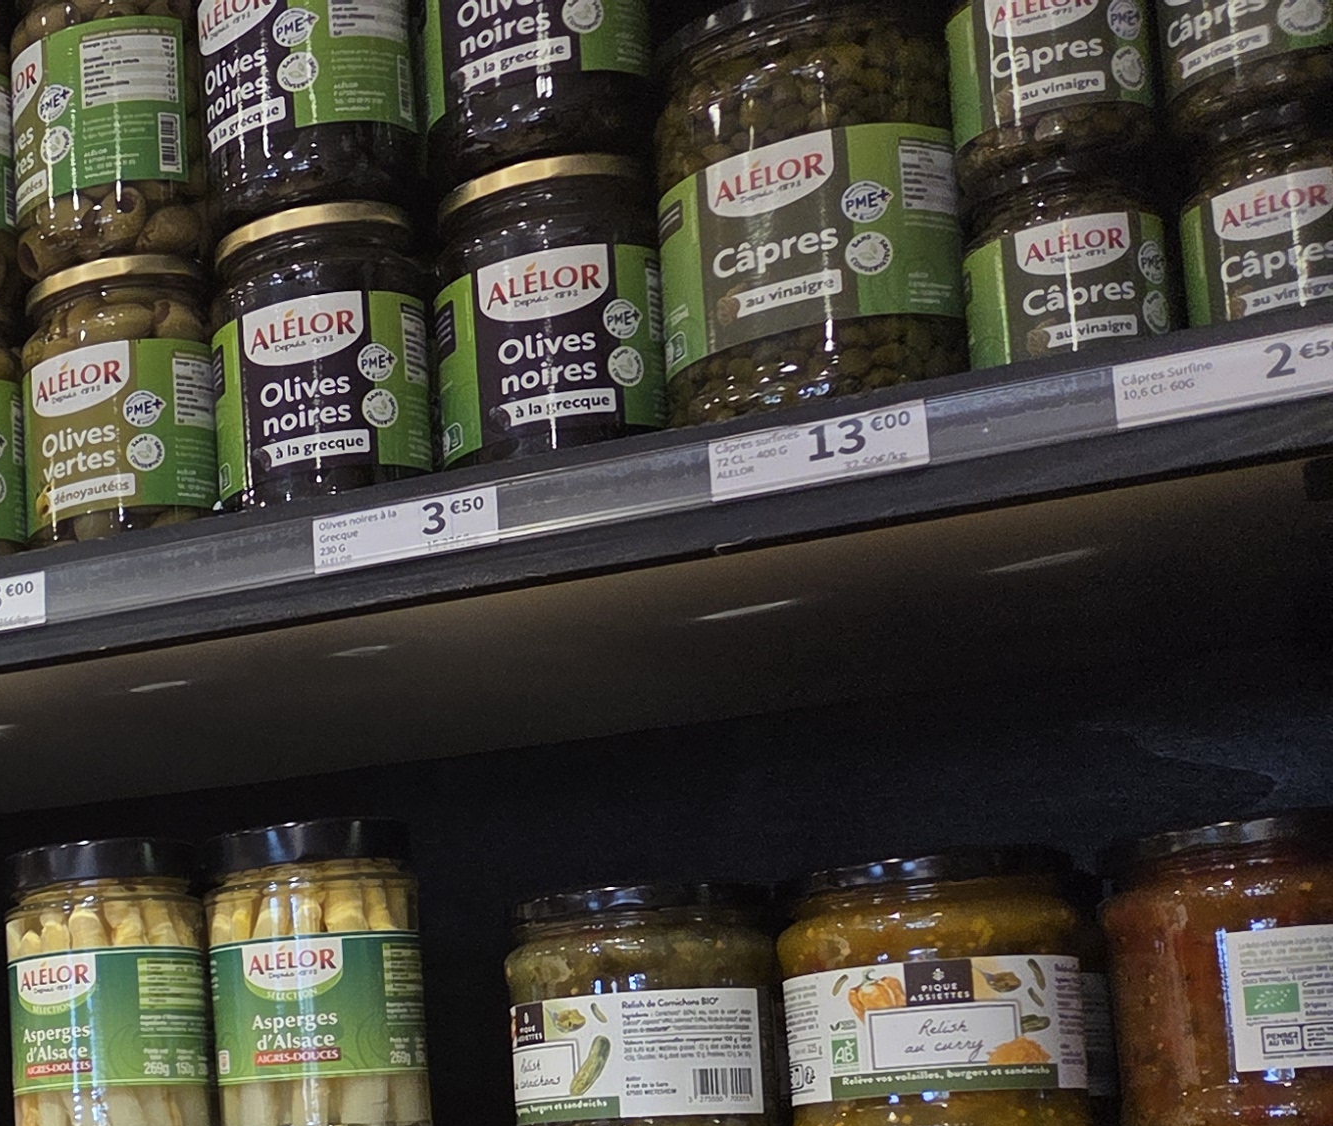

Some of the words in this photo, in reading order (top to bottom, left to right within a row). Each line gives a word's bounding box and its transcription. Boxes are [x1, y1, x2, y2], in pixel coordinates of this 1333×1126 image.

[459, 10, 551, 58] noires
[204, 46, 268, 94] Olives
[991, 37, 1104, 79] Câpres
[205, 76, 268, 125] noires
[714, 149, 825, 208] ALÉLOR
[1220, 183, 1328, 233] ALÉLOR
[712, 226, 839, 279] Câpres
[1025, 226, 1125, 267] ALÉLOR
[745, 291, 765, 307] au
[767, 275, 835, 305] vinaigre
[1023, 280, 1135, 316] Câpres
[249, 309, 356, 355] ALÉLOR
[497, 331, 597, 366] Olives
[260, 374, 351, 408] Olives
[500, 360, 597, 395] noires
[262, 402, 352, 436] noires
[808, 417, 866, 462] 13
[870, 411, 911, 431] €00
[42, 424, 116, 458] Olives
[422, 501, 446, 535] 3
[450, 496, 484, 514] €50
[319, 529, 359, 544] Grecque
[21, 961, 90, 991] ALÉLOR
[248, 945, 337, 976] ALÉLOR
[909, 989, 971, 1002] ASSIETTES
[921, 981, 959, 994] PIQUE
[22, 1024, 91, 1047] Asperges
[252, 1011, 338, 1035] Asperges
[918, 1018, 968, 1038] Relish
[389, 1049, 411, 1066] 269g
